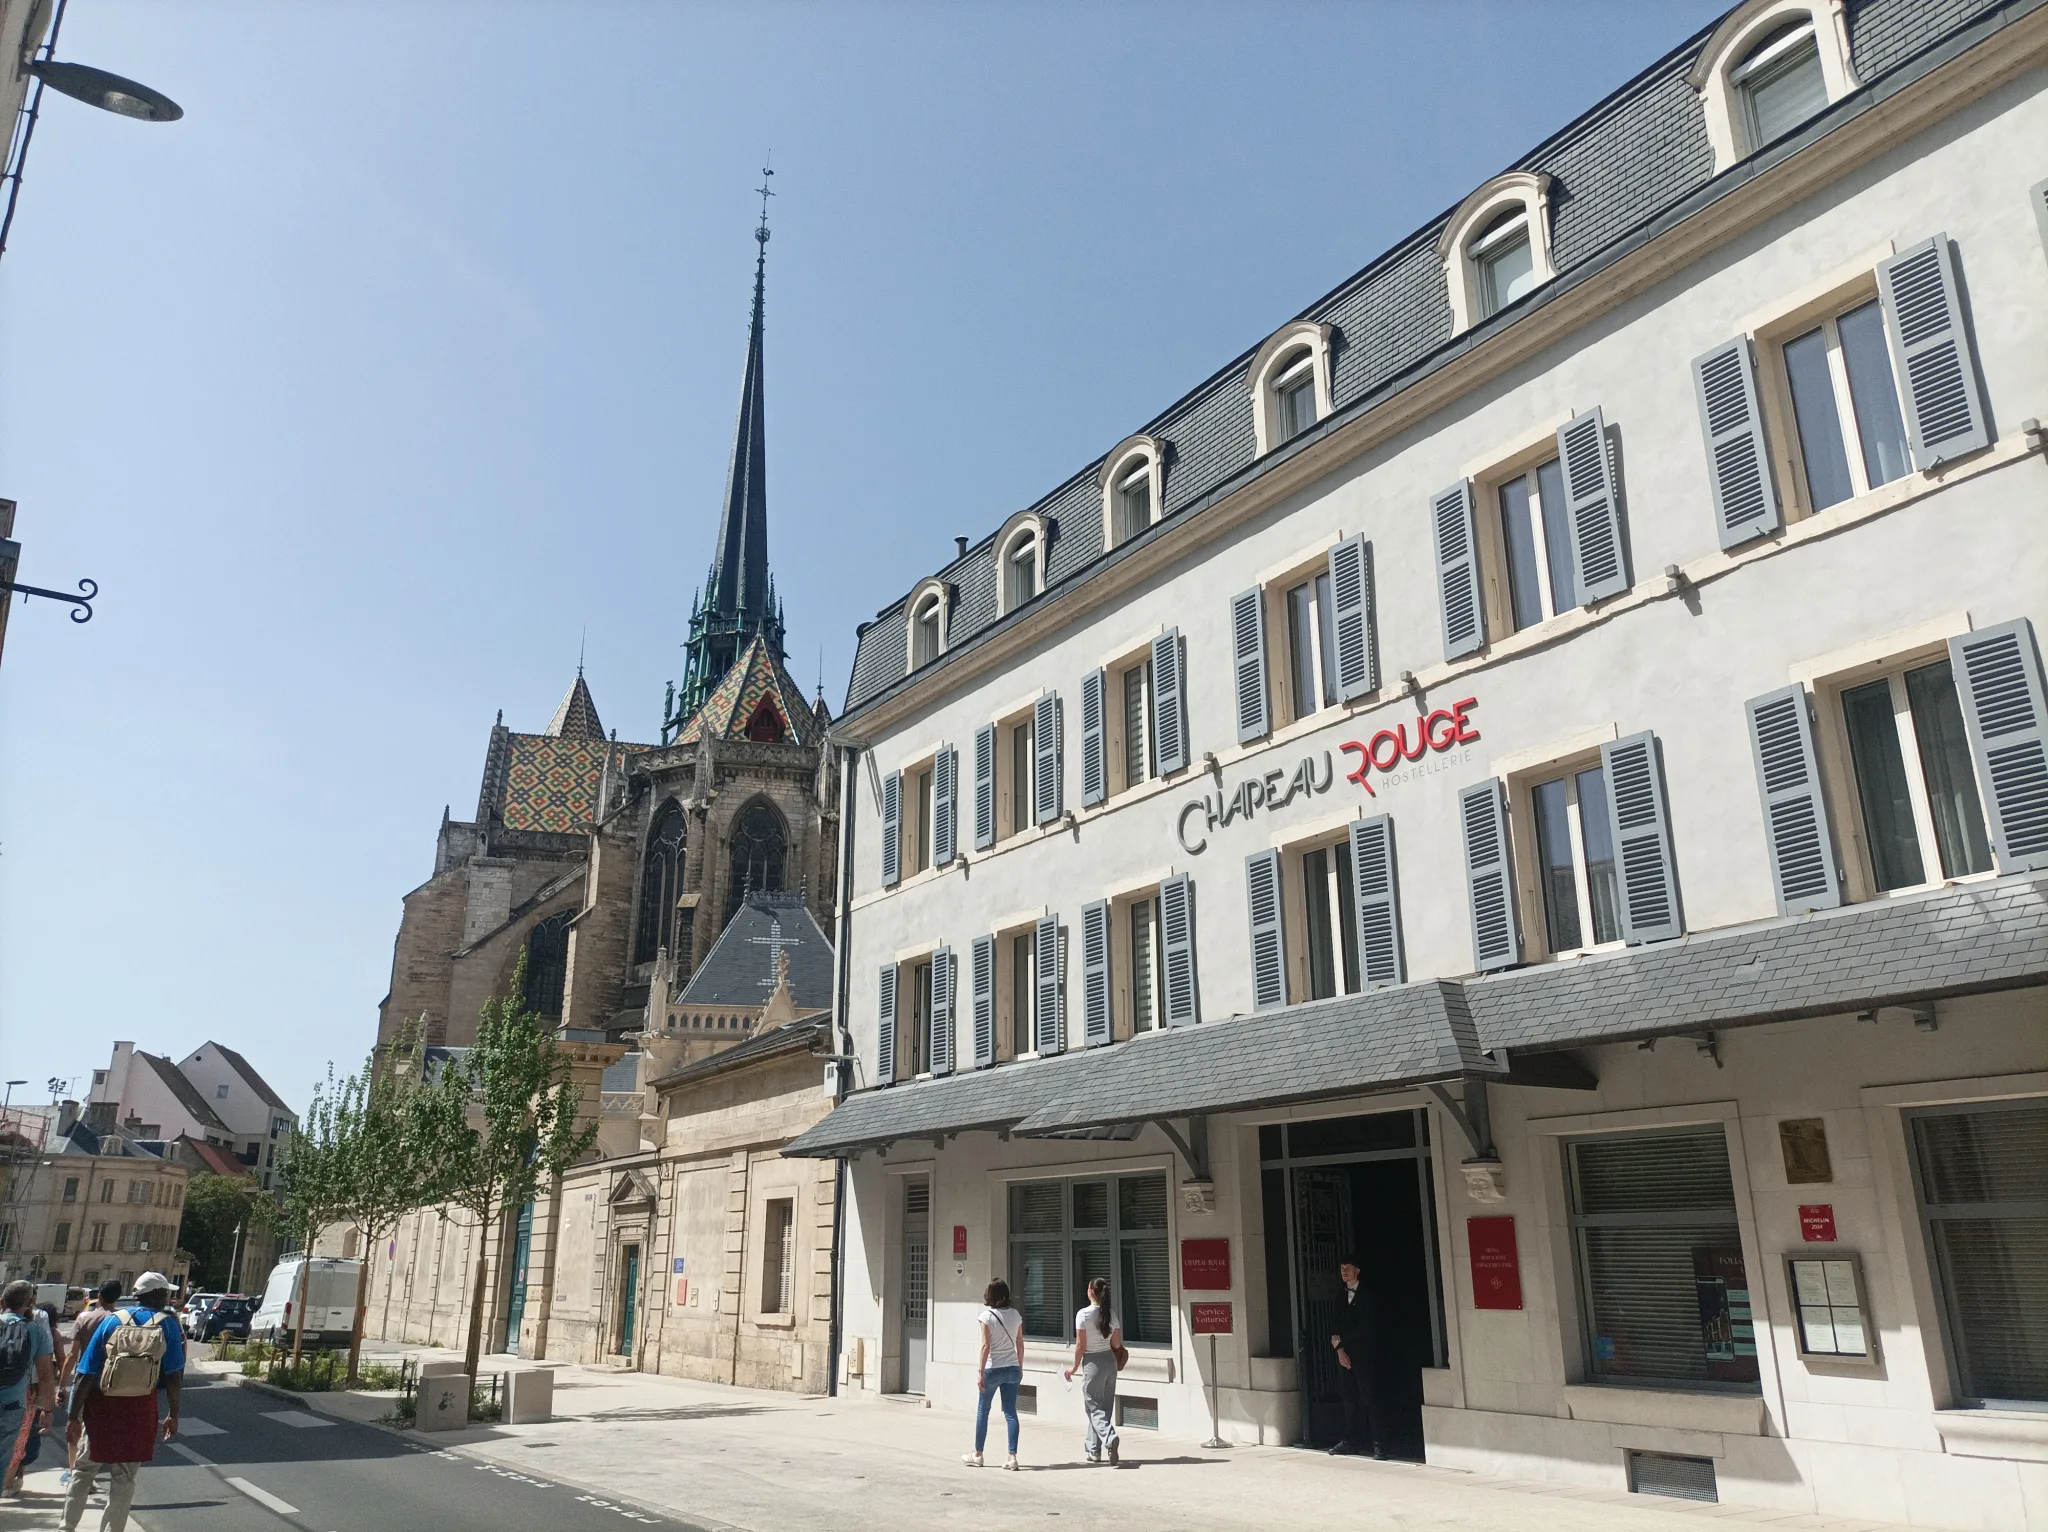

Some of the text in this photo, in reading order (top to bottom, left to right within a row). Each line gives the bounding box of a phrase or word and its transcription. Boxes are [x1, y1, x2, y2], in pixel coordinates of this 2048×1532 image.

[1177, 697, 1479, 852] CHAPEAU ROUGE
[1382, 749, 1472, 790] HOSTELLERIE
